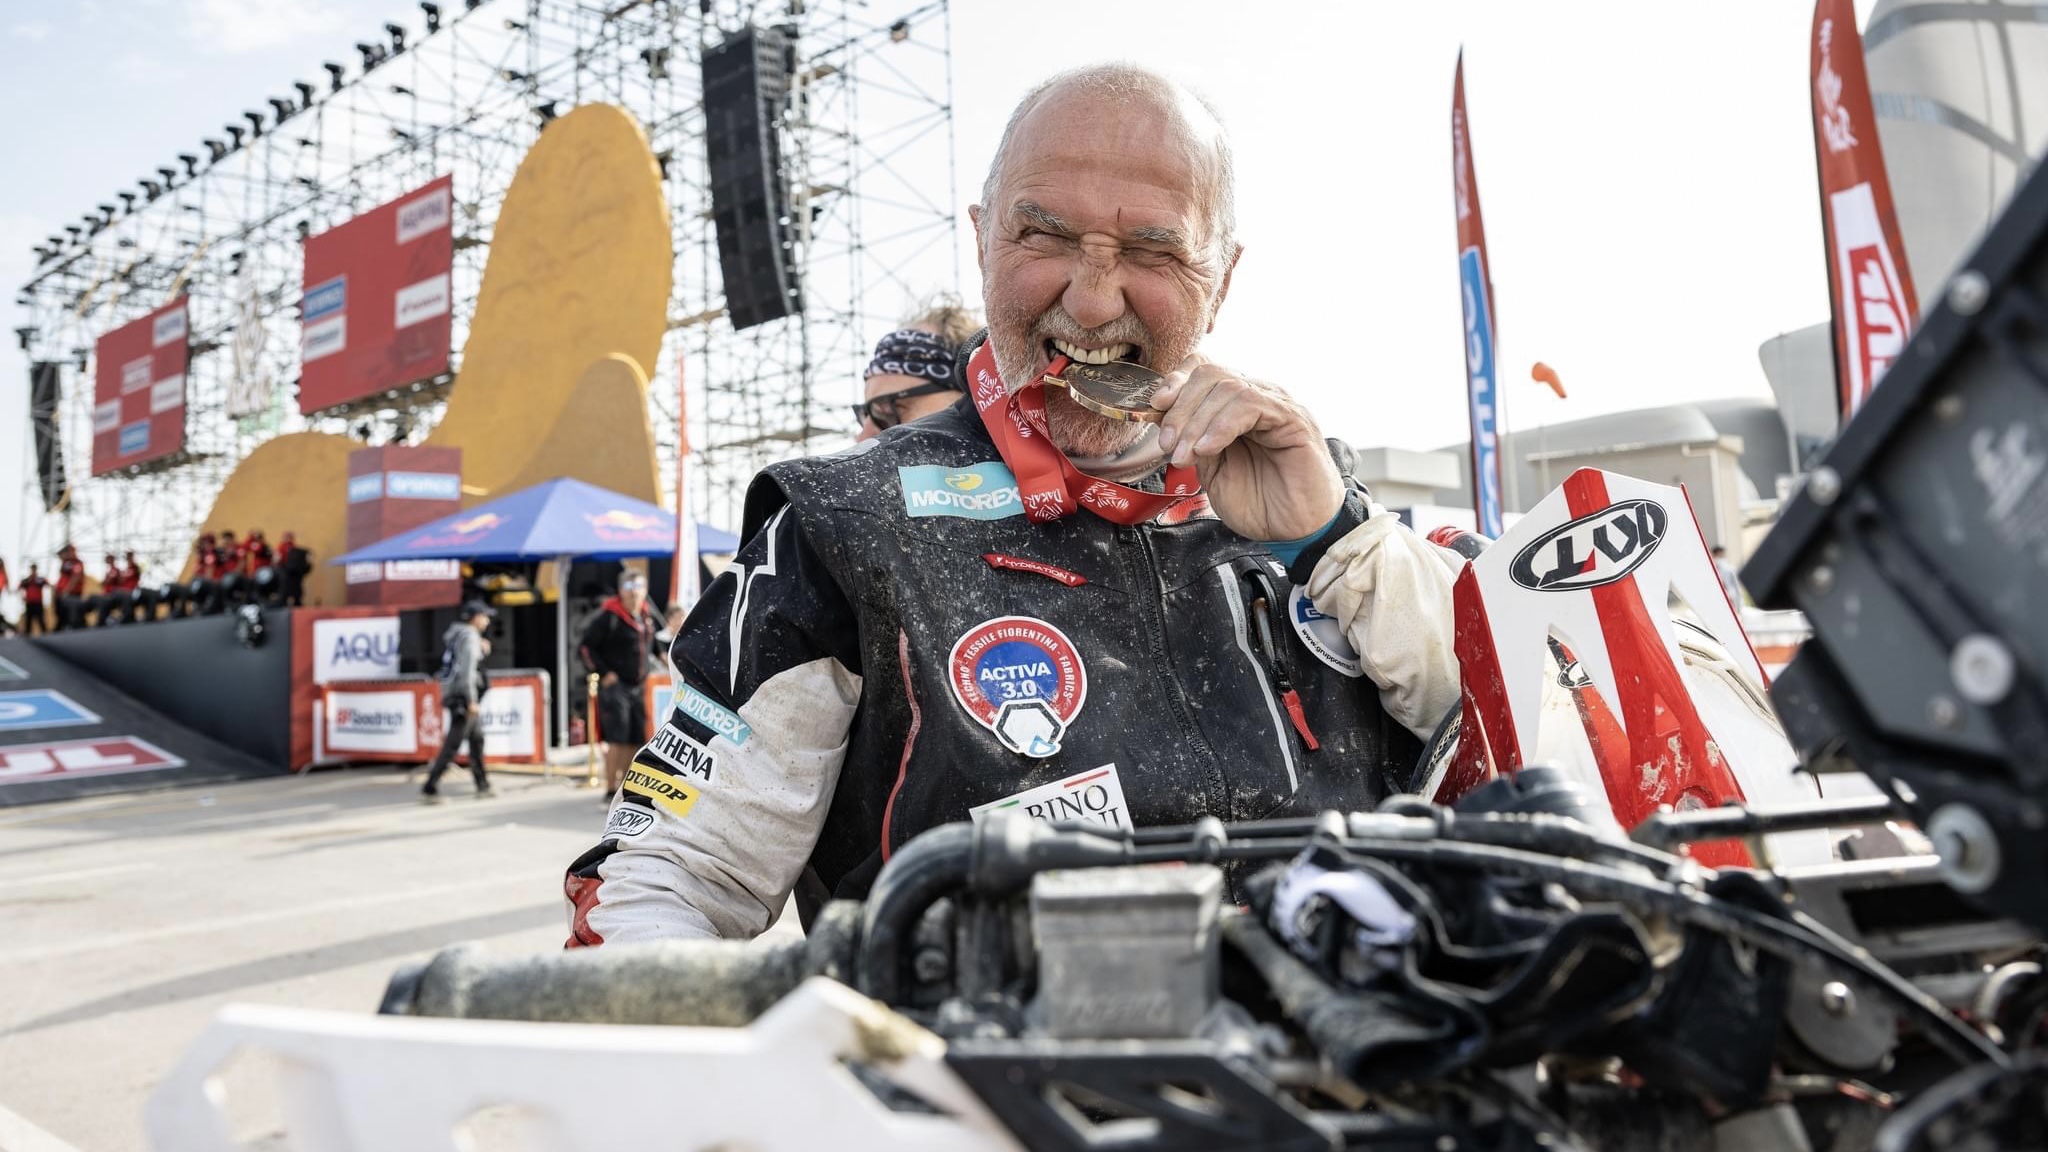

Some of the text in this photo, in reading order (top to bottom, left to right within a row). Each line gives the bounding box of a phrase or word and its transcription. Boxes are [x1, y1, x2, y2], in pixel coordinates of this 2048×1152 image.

[911, 487, 1021, 510] MOTOREX
[1005, 559, 1068, 580] HYDRATION
[963, 632, 997, 660] TESSILE
[997, 627, 1058, 652] FIORENTINA
[960, 666, 977, 703] TECHNO
[980, 661, 1051, 681] ACTIVA
[1058, 655, 1076, 700] FABRICS
[1000, 679, 1037, 698] 3.0
[684, 688, 747, 740] MOTOREX
[651, 729, 714, 781] ATHENA
[625, 770, 688, 801] DUNLOP
